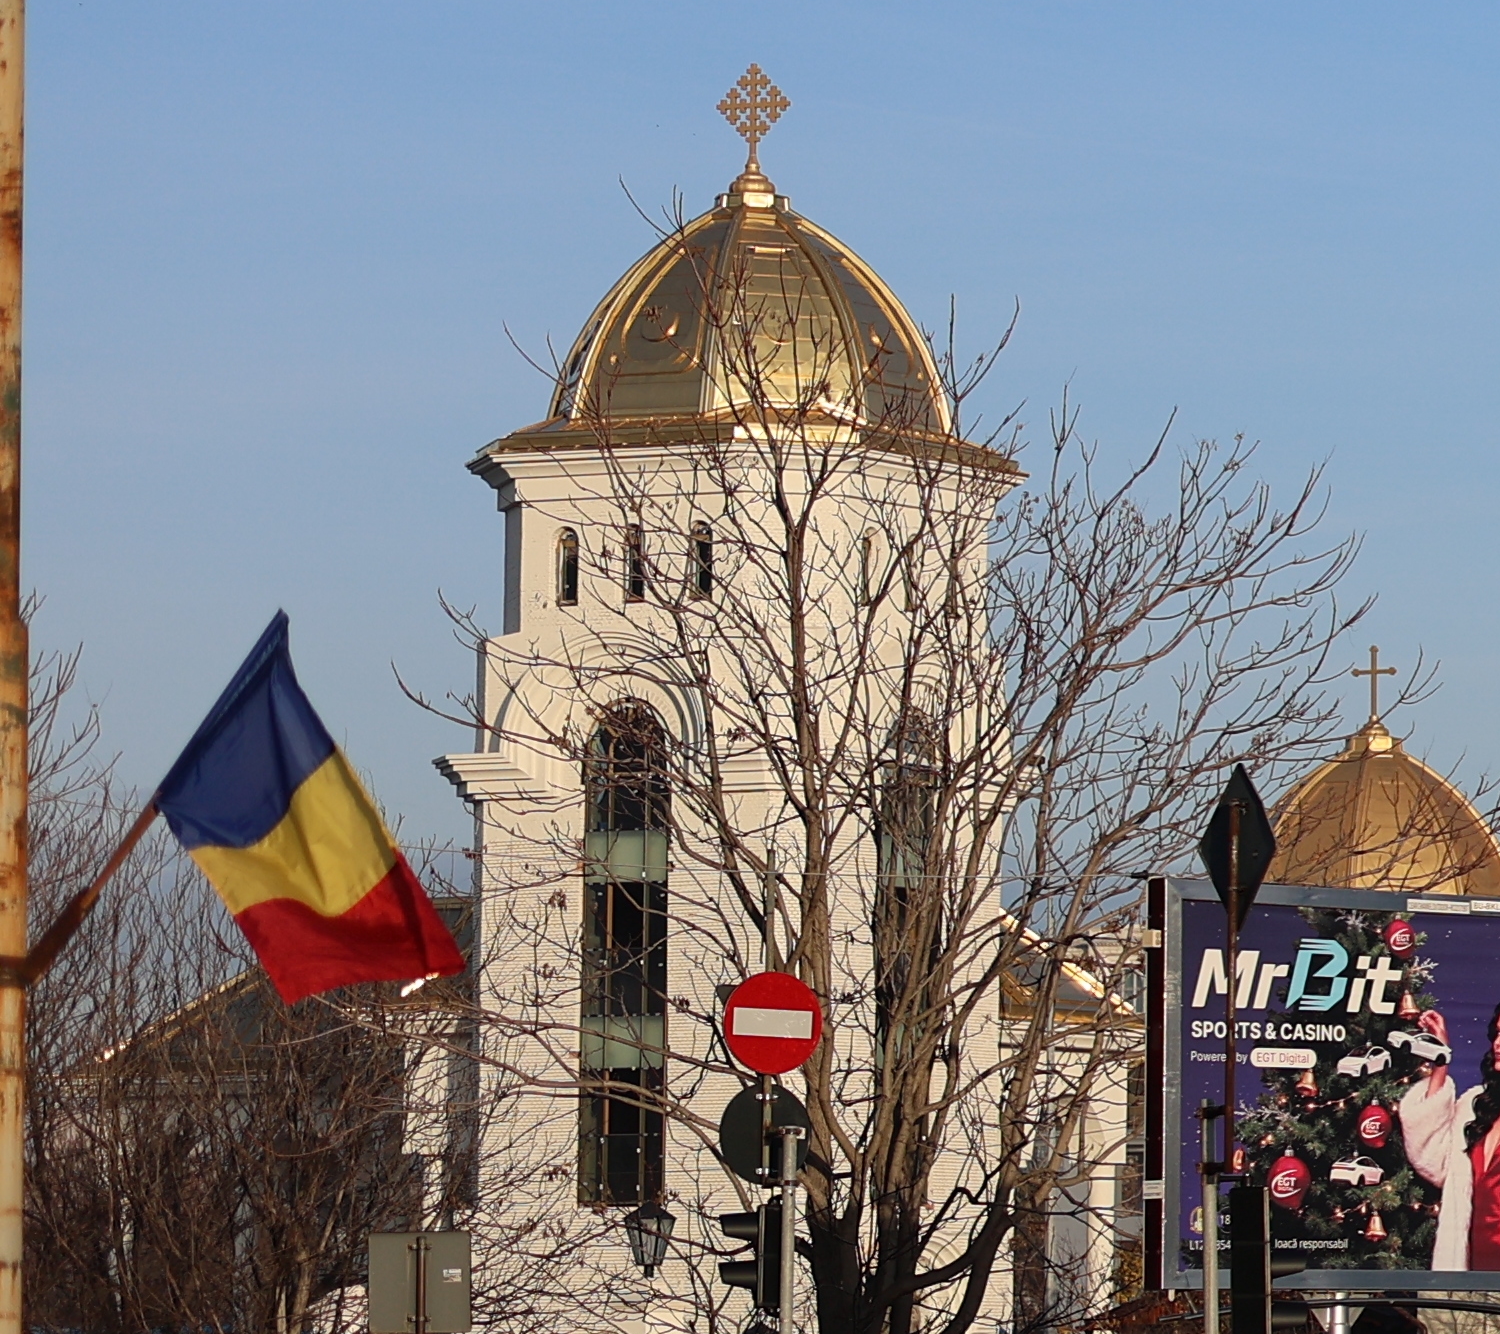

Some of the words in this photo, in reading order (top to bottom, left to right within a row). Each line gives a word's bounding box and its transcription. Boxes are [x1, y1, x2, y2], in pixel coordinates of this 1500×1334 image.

[1192, 938, 1403, 1015] MrBit
[1265, 1023, 1277, 1040] &
[1280, 1023, 1346, 1042] CASINO
[1190, 1050, 1227, 1062] Powere
[1236, 1052, 1248, 1064] by
[1256, 1052, 1275, 1062] EGT
[1279, 1053, 1309, 1065] Digital
[1277, 1177, 1297, 1187] EGT
[1299, 1238, 1349, 1251] responsabil
